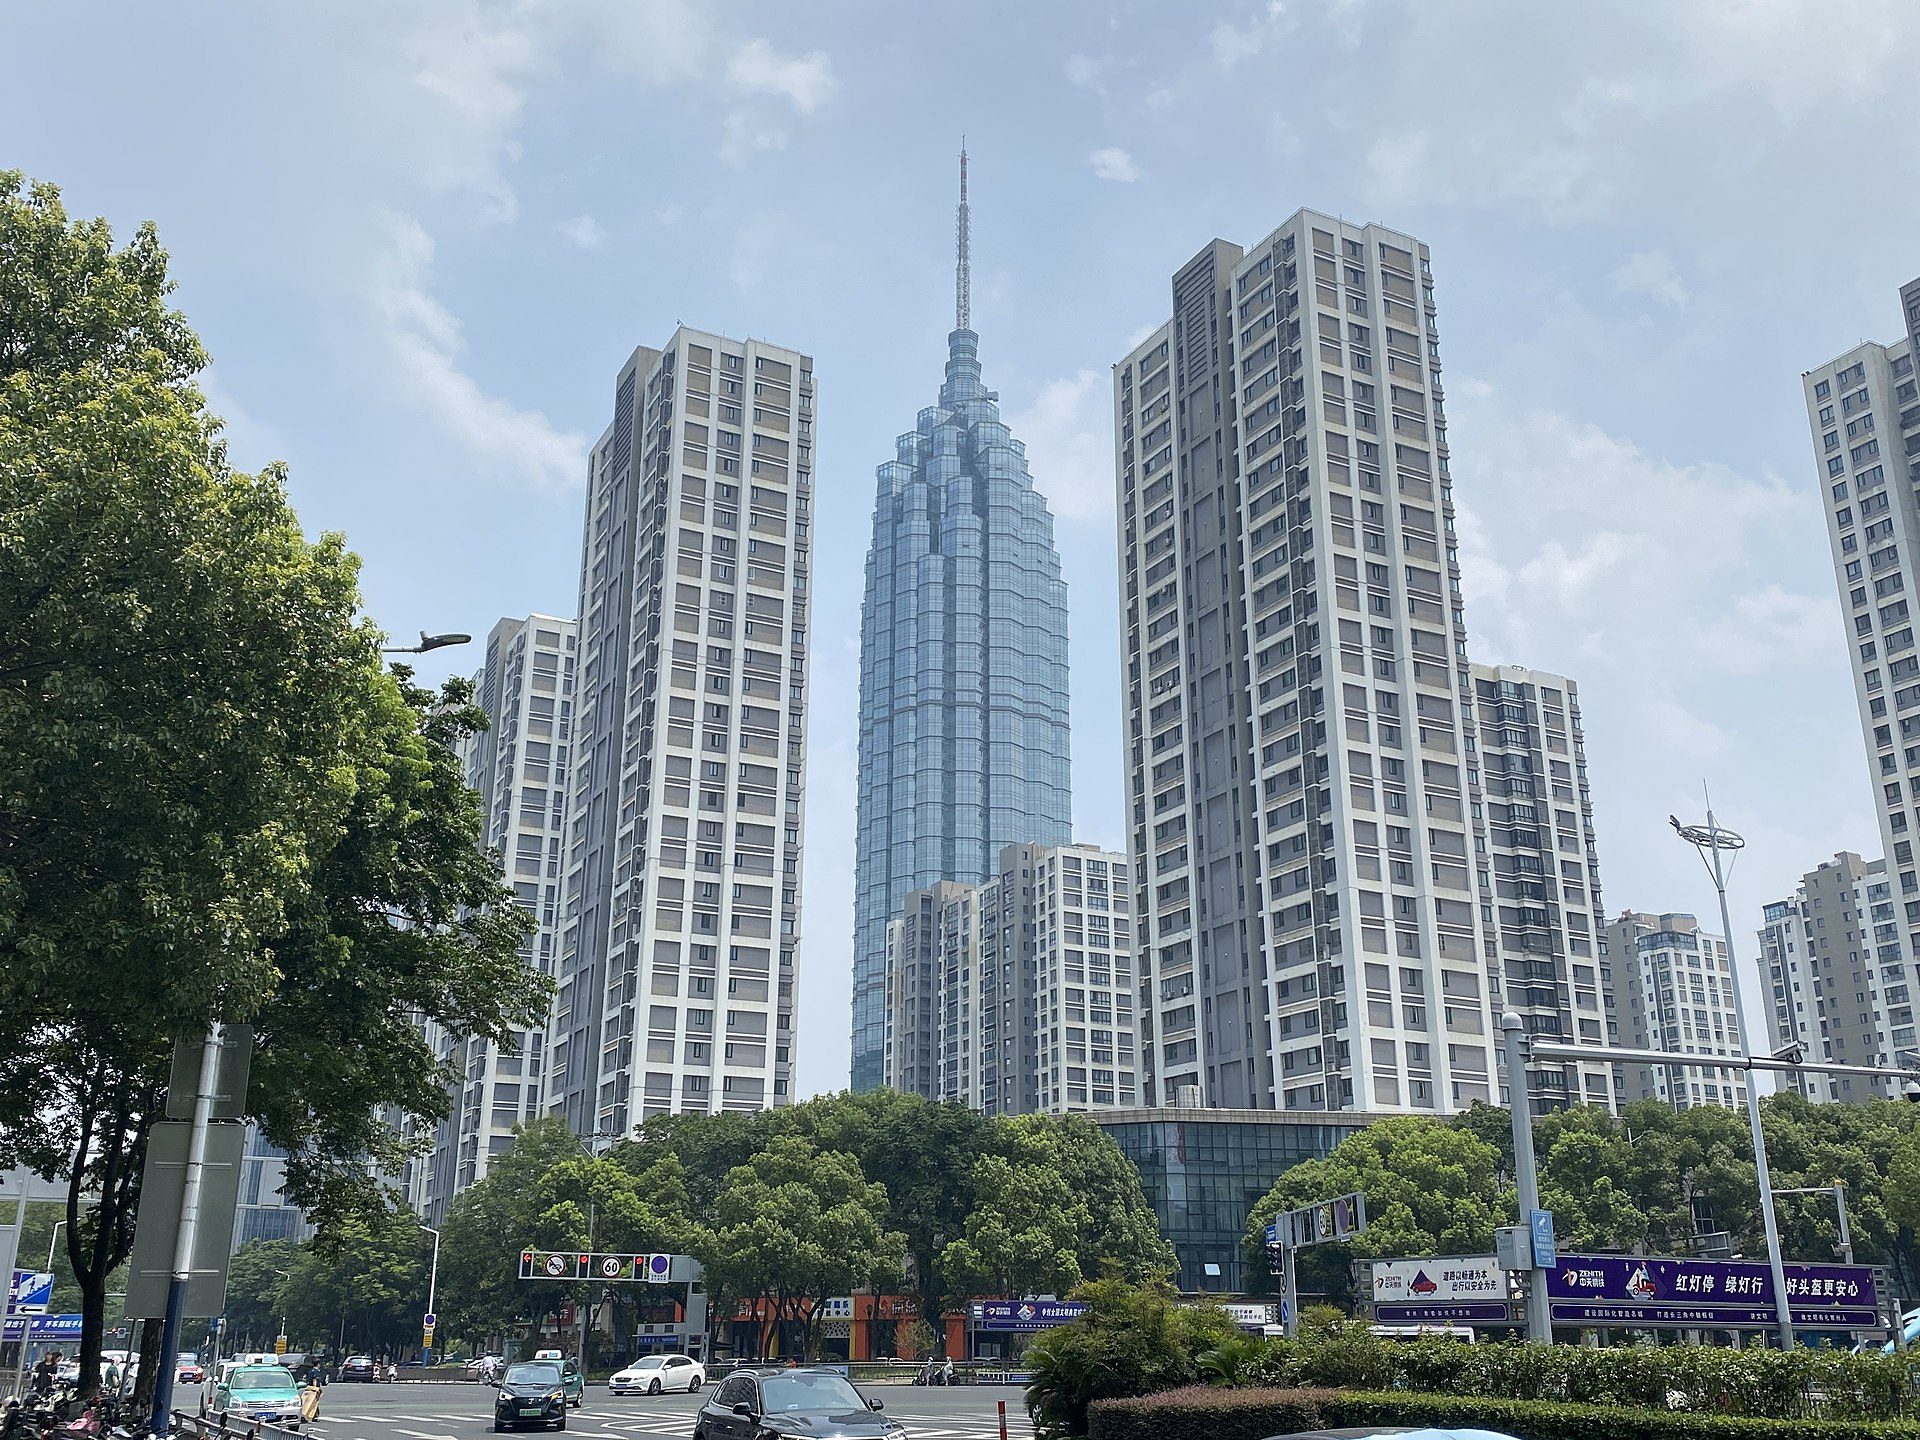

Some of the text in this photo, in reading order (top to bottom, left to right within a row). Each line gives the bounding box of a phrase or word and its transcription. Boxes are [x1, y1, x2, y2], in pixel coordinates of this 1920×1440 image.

[605, 1261, 617, 1272] 60
[1443, 1270, 1488, 1281] 道路以畅通为本
[1579, 1269, 1604, 1278] ZENITH
[1579, 1278, 1605, 1288] 中天钢铁
[1675, 1274, 1859, 1297] 红灯停 绿灯行 好头盔更安心
